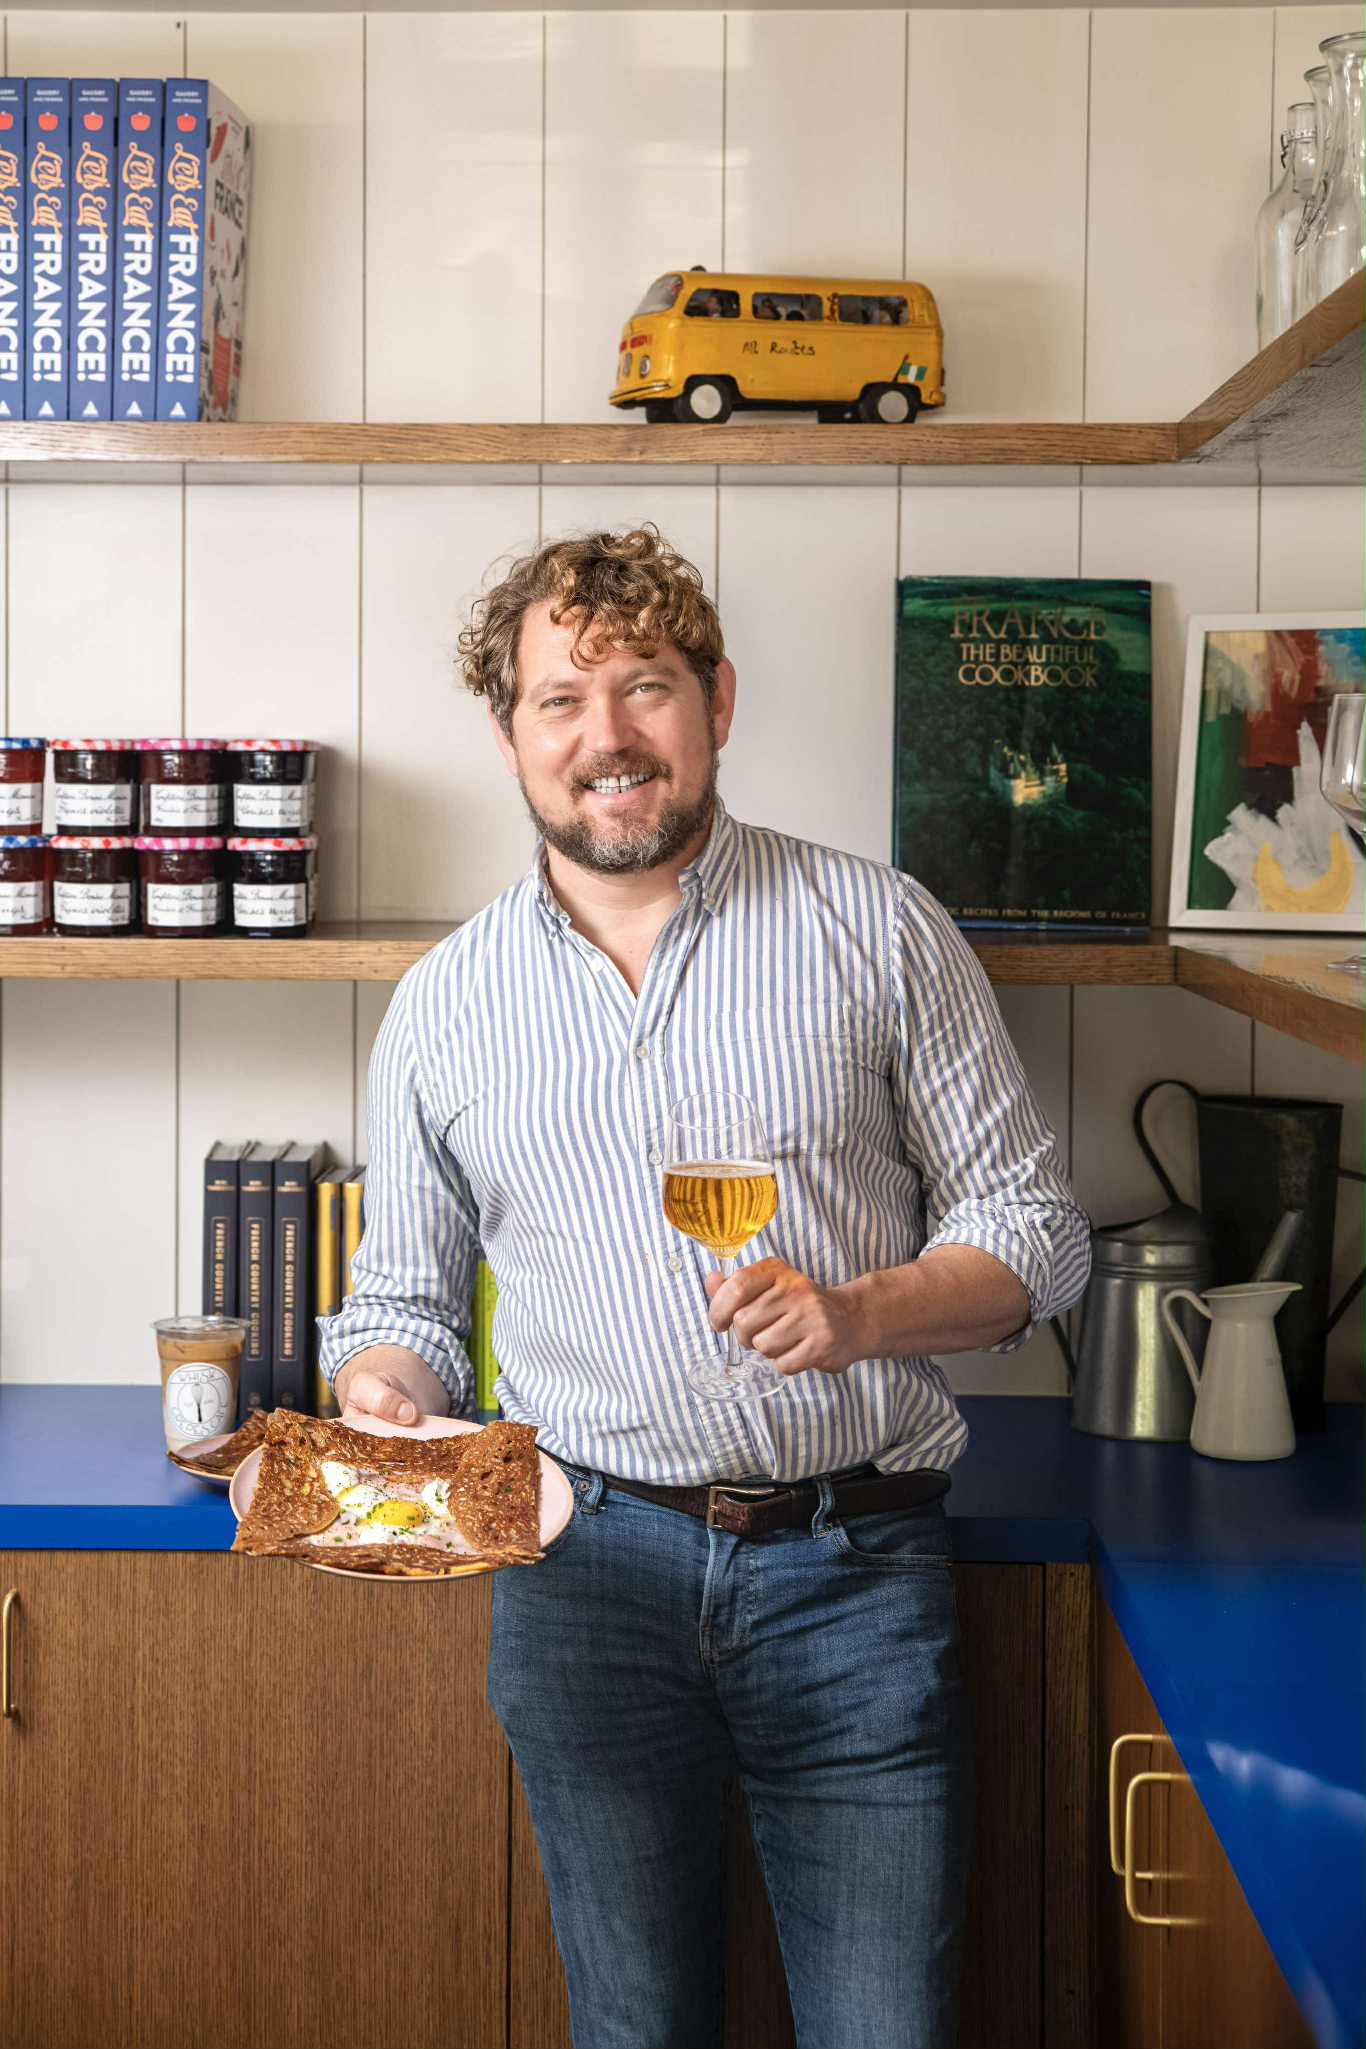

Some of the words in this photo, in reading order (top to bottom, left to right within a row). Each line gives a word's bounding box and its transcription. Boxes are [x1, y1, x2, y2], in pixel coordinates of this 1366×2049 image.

[31, 192, 63, 239] Eat
[76, 192, 108, 239] Eat
[122, 192, 154, 240] Eat
[168, 193, 199, 240] Eat
[32, 233, 62, 382] FRANCE!
[77, 233, 107, 382] FRANCE!
[121, 233, 153, 382] FRANCE!
[165, 234, 198, 383] FRANCE!
[950, 602, 1106, 640] FRANCE
[958, 663, 1097, 688] COOKBOOK
[960, 642, 996, 662] THE
[1000, 643, 1098, 665] BEAUTIFUL
